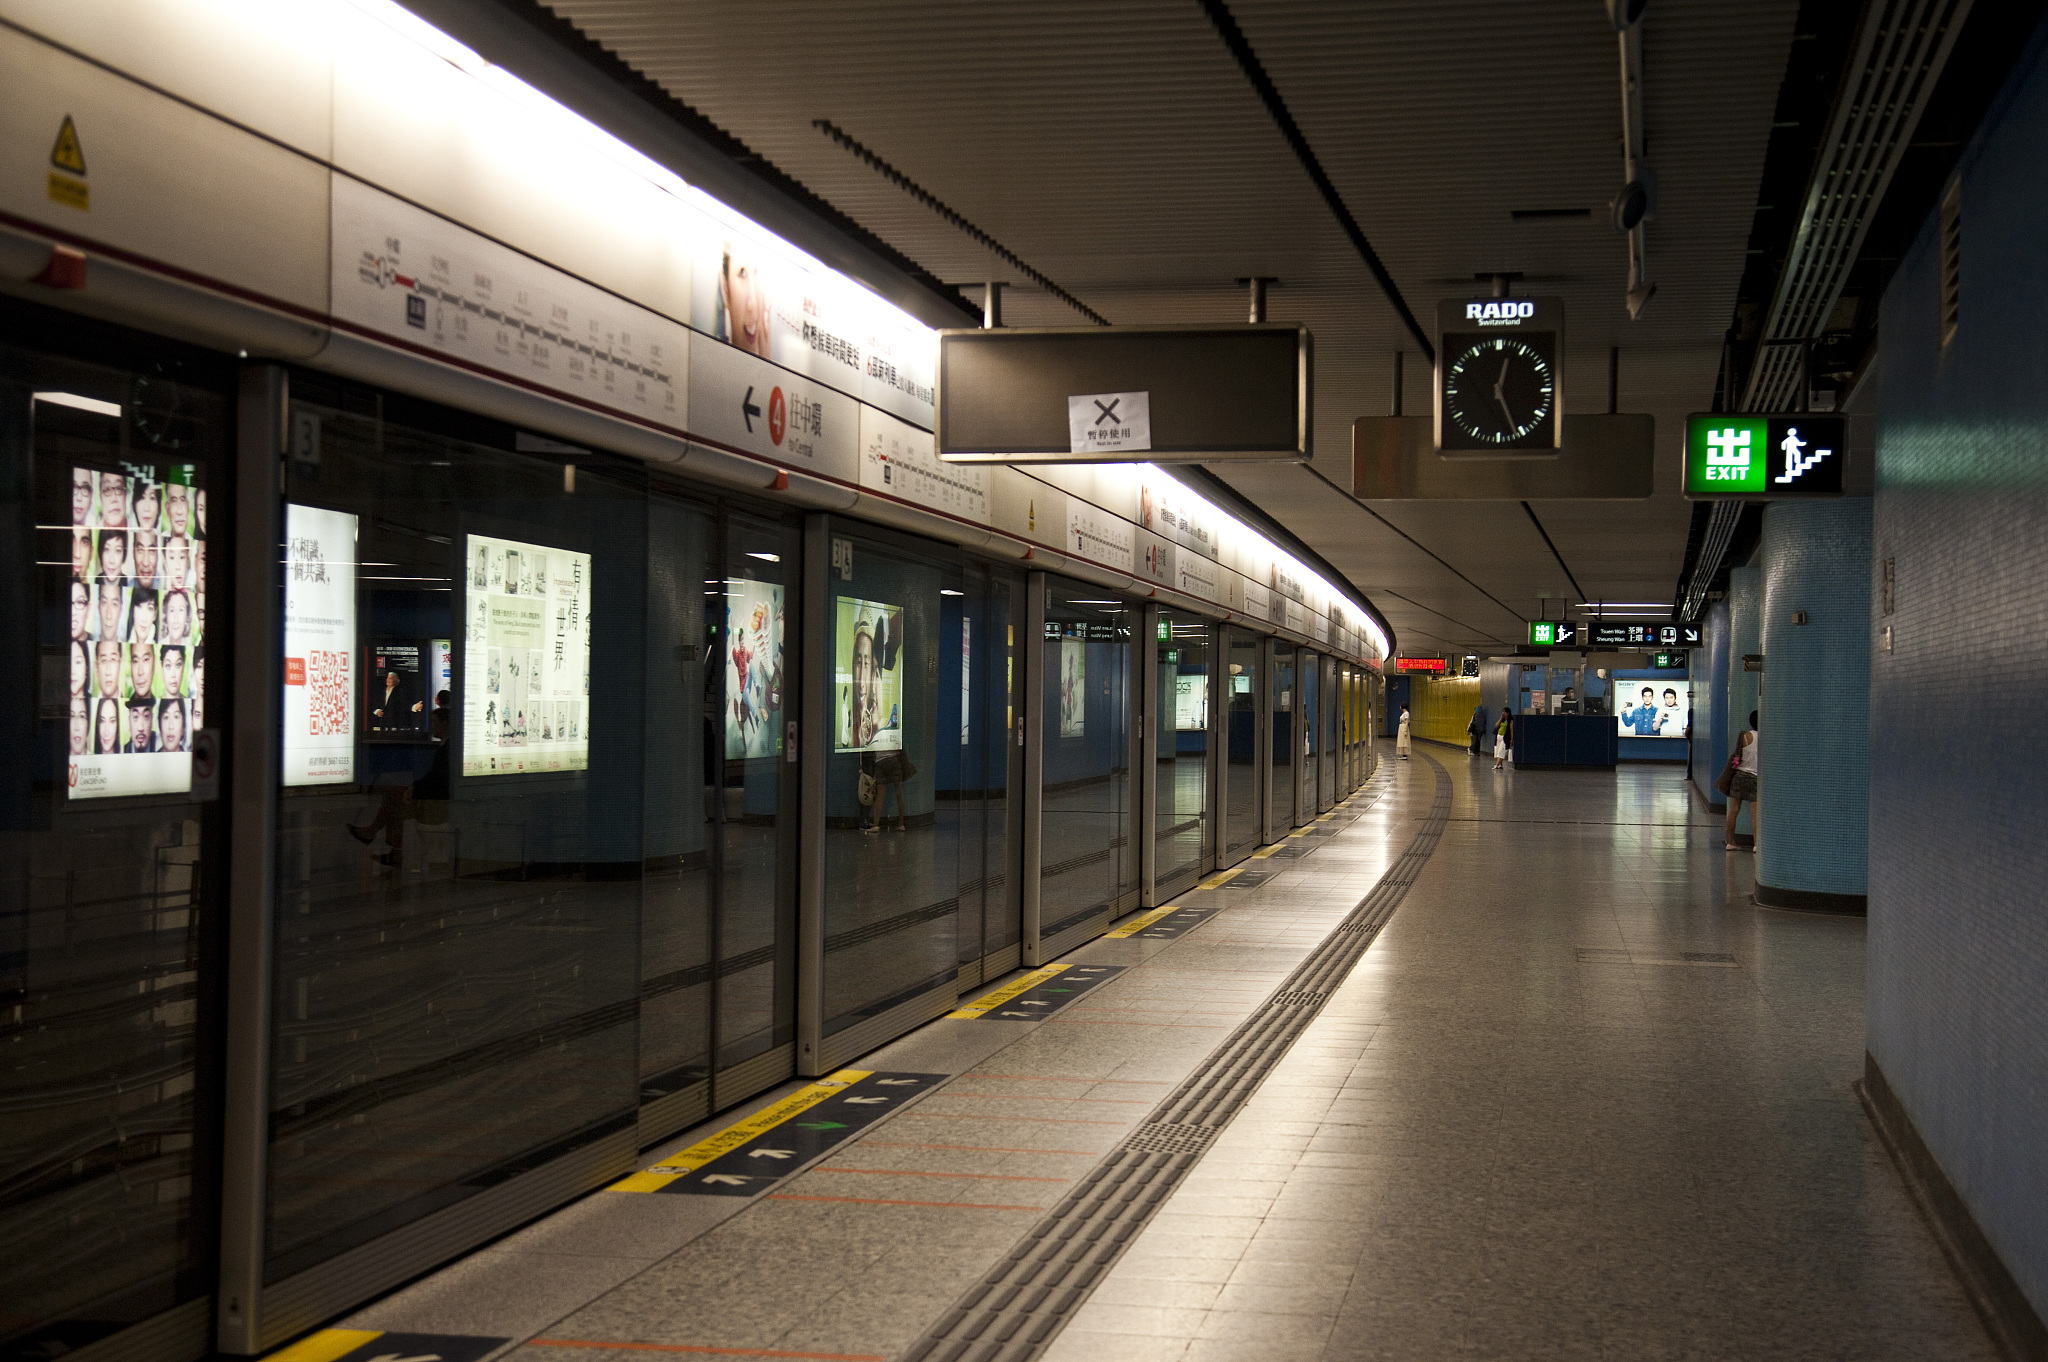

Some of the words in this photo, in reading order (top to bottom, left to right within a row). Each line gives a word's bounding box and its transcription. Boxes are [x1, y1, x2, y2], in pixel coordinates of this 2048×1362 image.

[1466, 302, 1534, 319] RADO
[1478, 318, 1521, 326] Switzerland
[773, 398, 782, 435] 4
[1087, 428, 1131, 440] 暫停使用
[1706, 428, 1751, 466] 出
[1706, 466, 1750, 480] EXIT
[1535, 625, 1550, 636] 出
[1628, 626, 1643, 635] 荃灣
[1628, 634, 1643, 642] 上環
